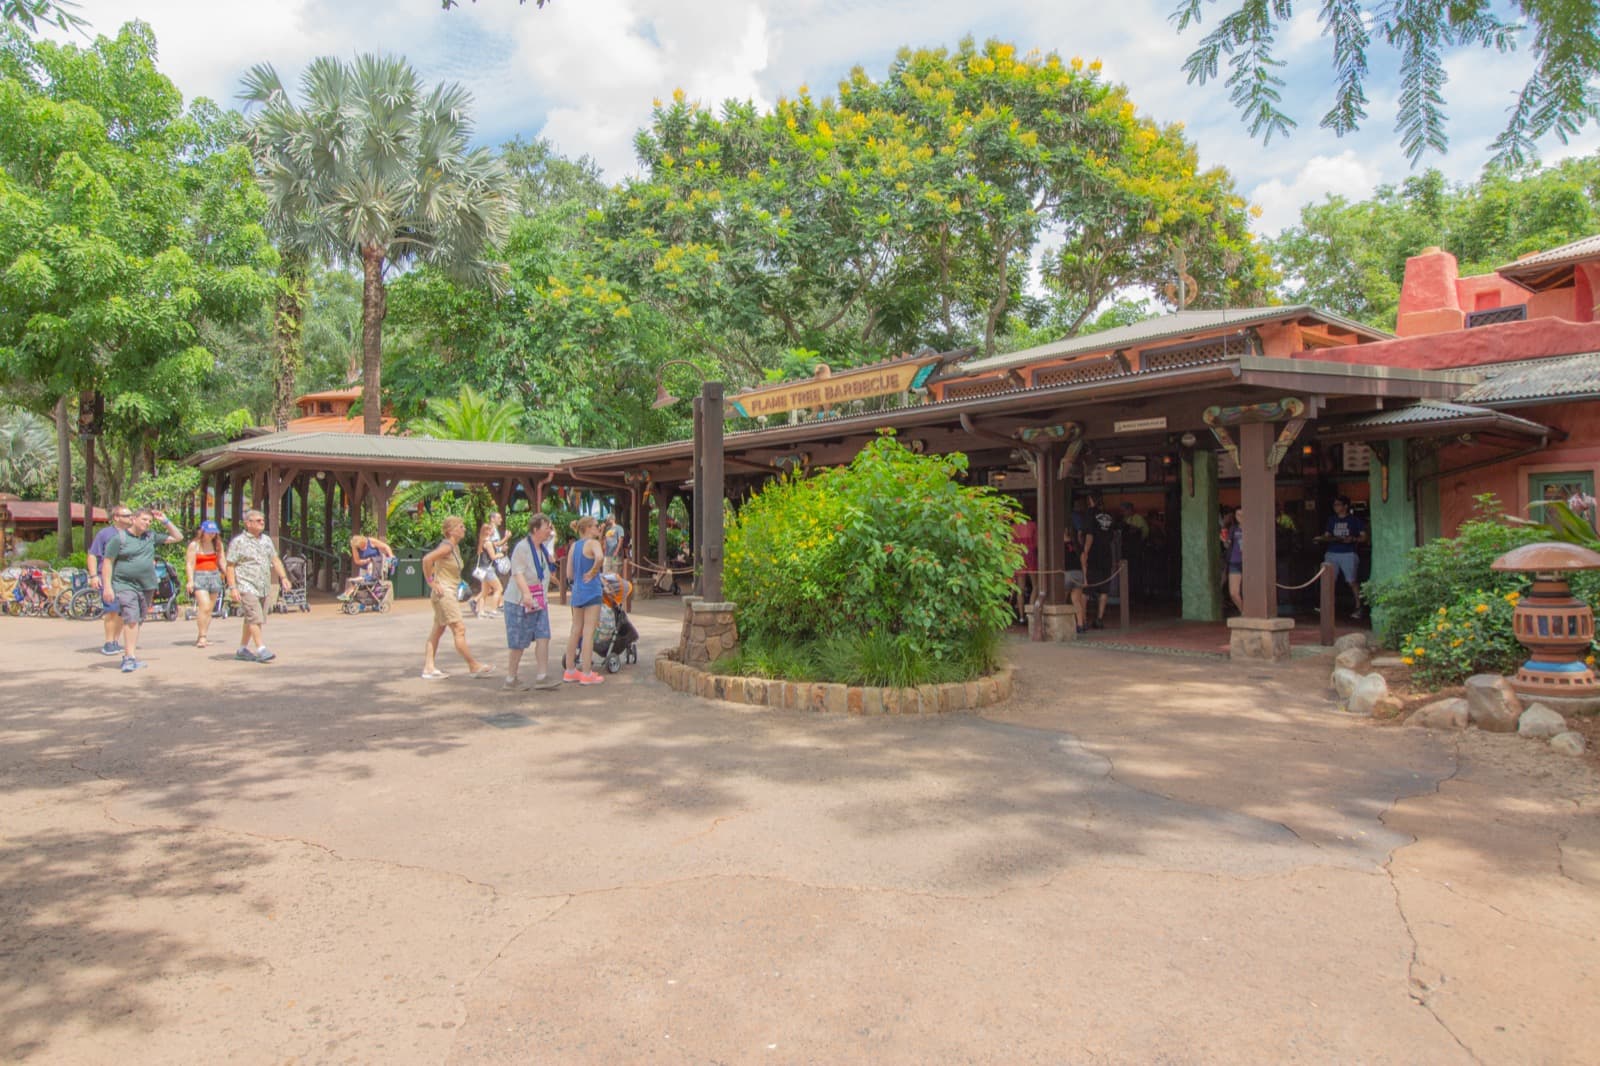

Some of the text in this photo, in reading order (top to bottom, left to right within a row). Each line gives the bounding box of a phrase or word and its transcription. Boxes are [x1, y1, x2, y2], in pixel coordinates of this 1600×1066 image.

[751, 374, 899, 412] FLAME TREE BARBECUE
